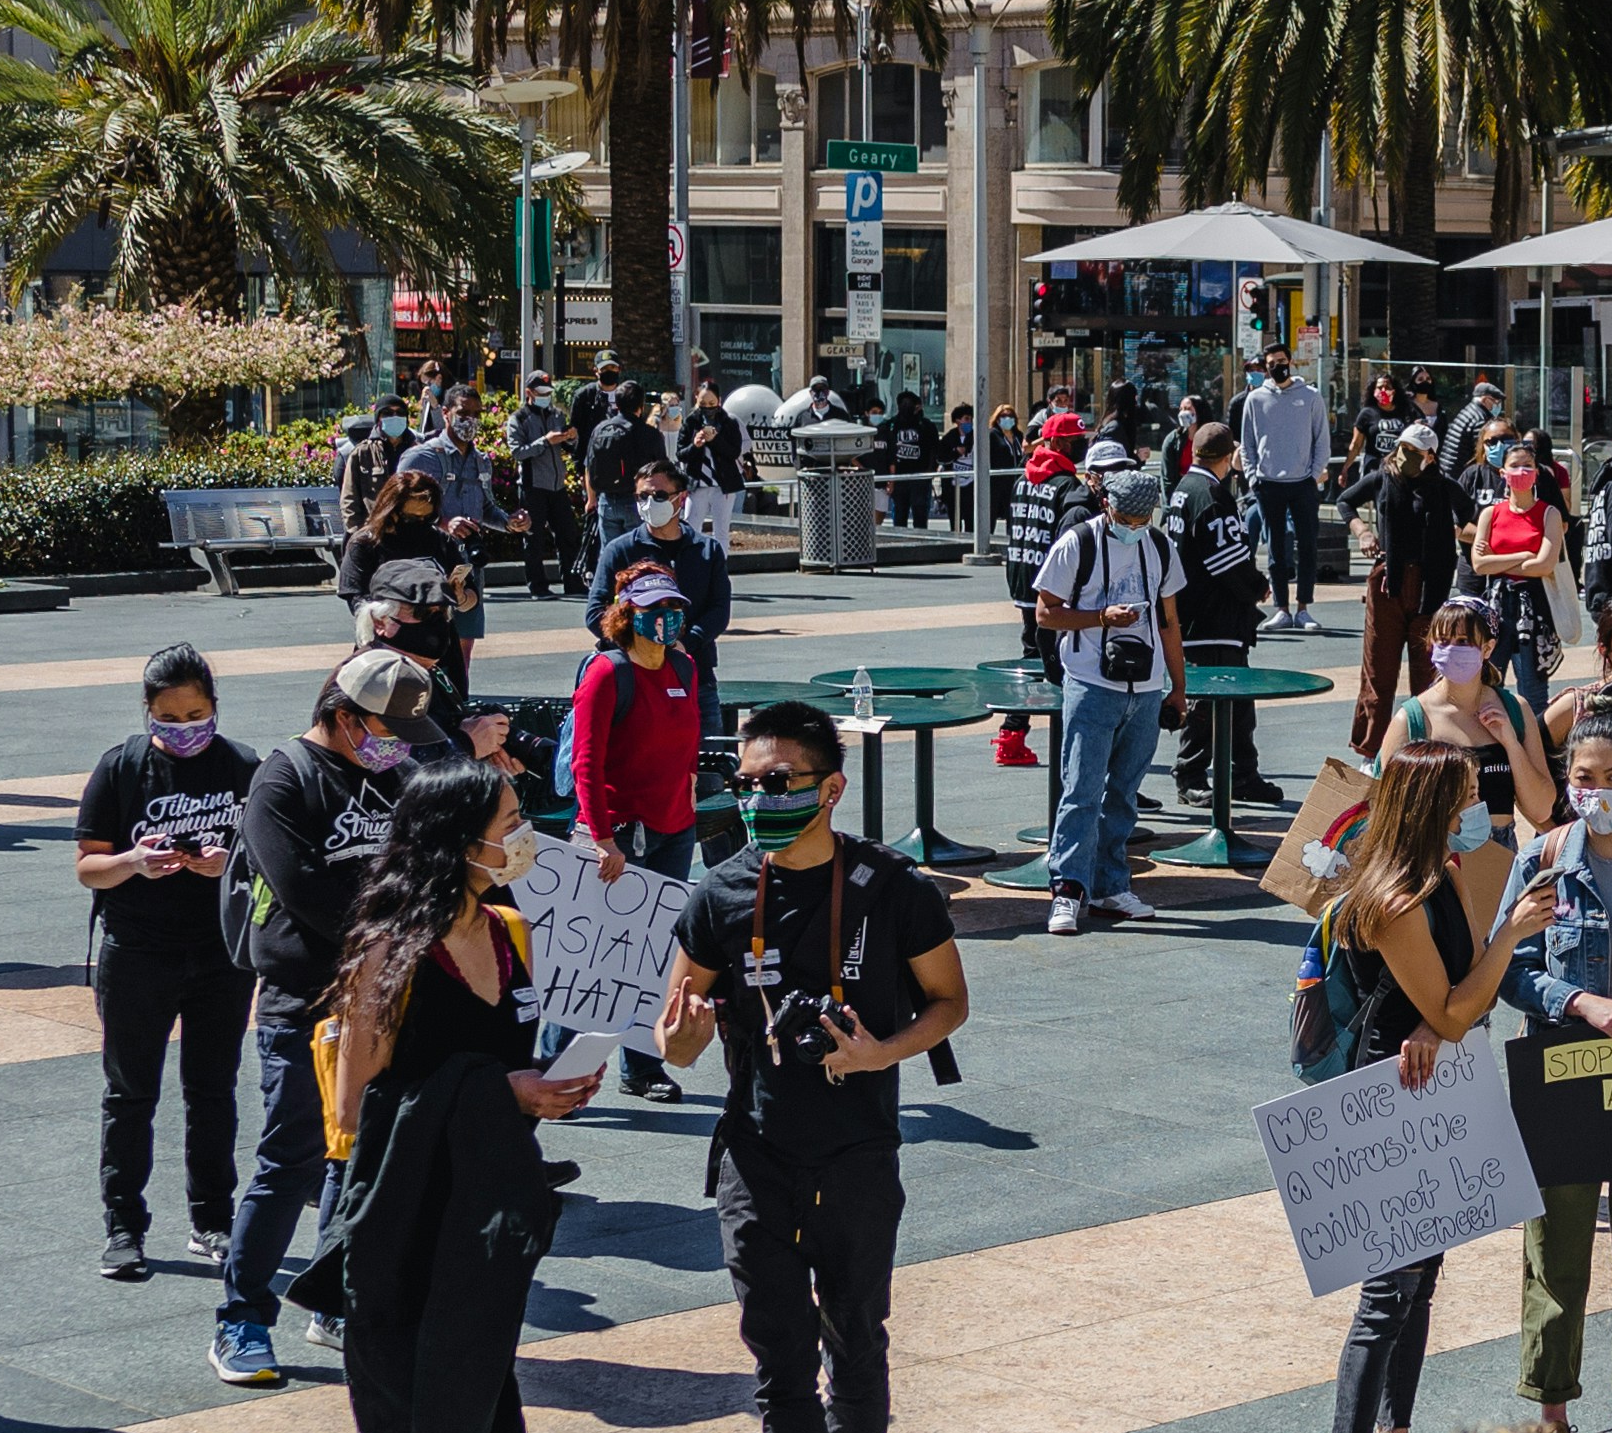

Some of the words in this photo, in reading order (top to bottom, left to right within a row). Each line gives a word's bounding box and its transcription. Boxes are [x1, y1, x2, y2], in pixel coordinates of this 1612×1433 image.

[848, 148, 898, 168] Geary
[851, 247, 879, 257] Stockton
[851, 256, 874, 266] Garage
[826, 346, 858, 355] GEARY
[753, 427, 789, 441] BLACK
[754, 441, 789, 452] LIVES
[752, 452, 792, 466] MATTE
[1015, 480, 1025, 496] IT
[1025, 481, 1057, 501] TAKES
[1027, 503, 1055, 524] HOOD
[1012, 525, 1024, 541] TO
[1024, 526, 1051, 545] SAVE
[147, 790, 234, 822] Filipino
[131, 803, 245, 848] Community
[527, 847, 691, 929] STOP
[529, 905, 678, 978] ASIAN
[1548, 1045, 1612, 1078] STOP
[1266, 1106, 1328, 1154] We
[1340, 1082, 1395, 1126] are
[1286, 1170, 1313, 1204] a
[1420, 1112, 1467, 1152] We
[1300, 1199, 1371, 1260] will
[1379, 1168, 1441, 1223] not
[1449, 1155, 1506, 1202] be
